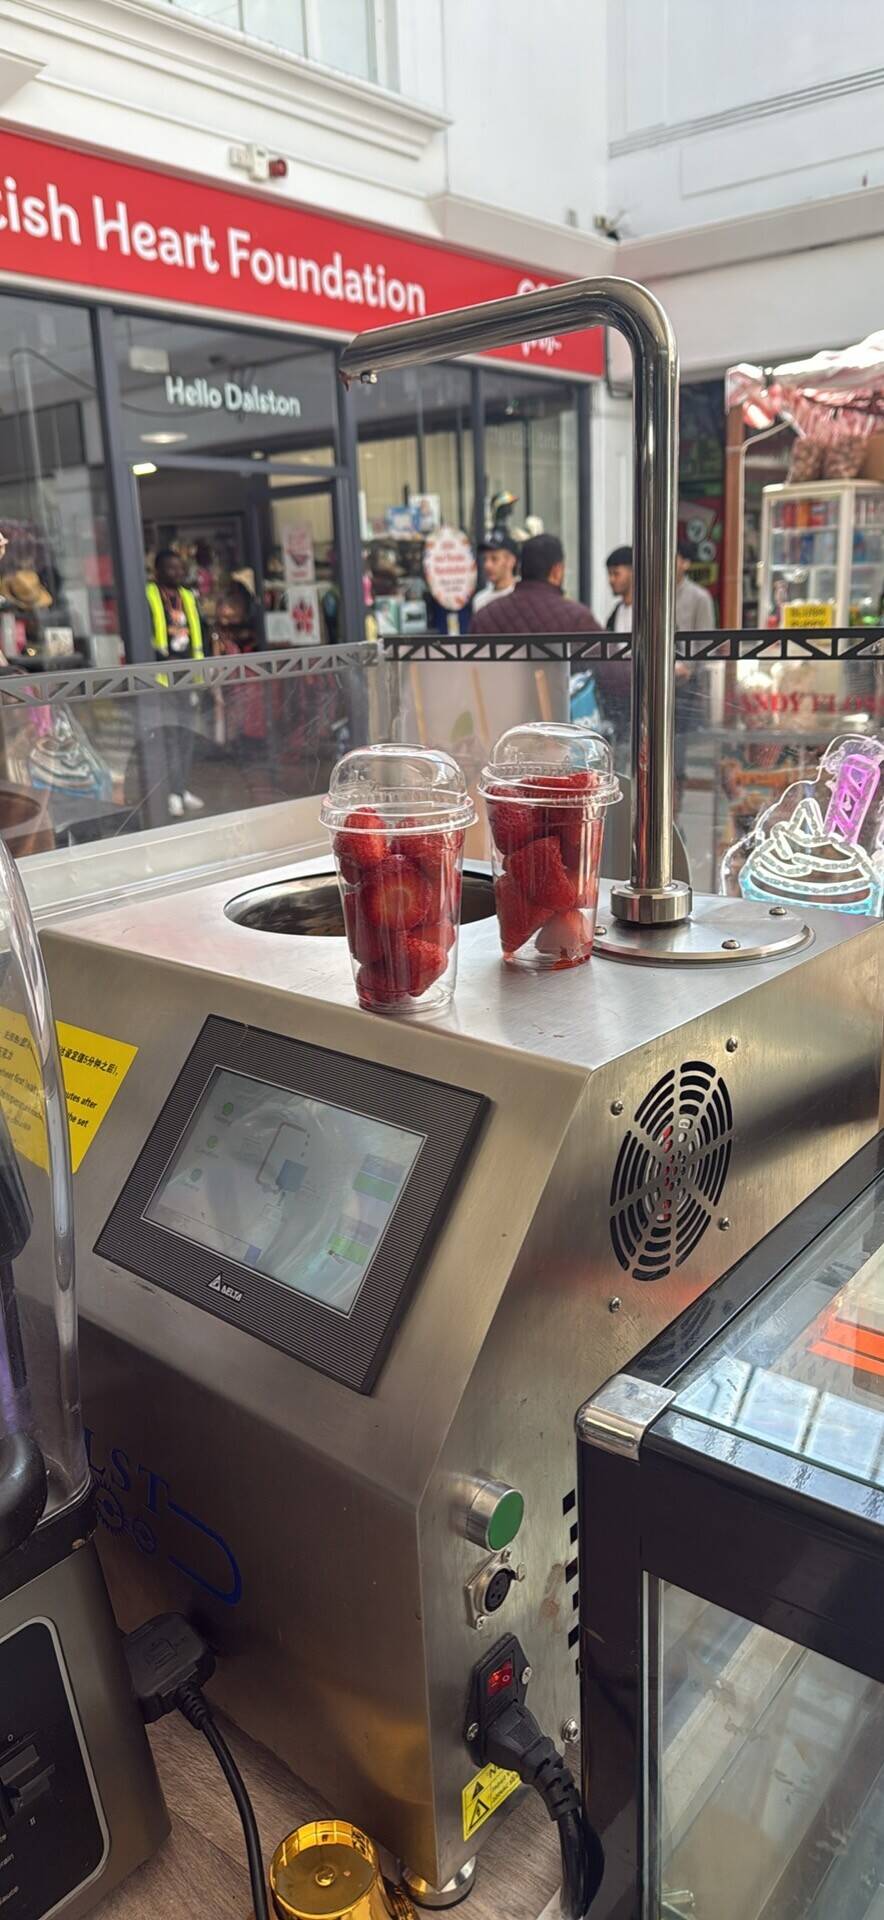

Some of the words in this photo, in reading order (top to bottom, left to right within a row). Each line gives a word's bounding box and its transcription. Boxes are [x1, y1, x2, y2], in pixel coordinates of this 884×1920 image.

[92, 195, 219, 274] Heart
[227, 227, 426, 316] Foundation
[165, 376, 222, 411] Hello
[223, 382, 301, 418] Dalston
[65, 1091, 81, 1104] utes
[80, 1097, 98, 1109] after
[77, 1116, 89, 1128] set
[221, 1285, 243, 1302] DELTA
